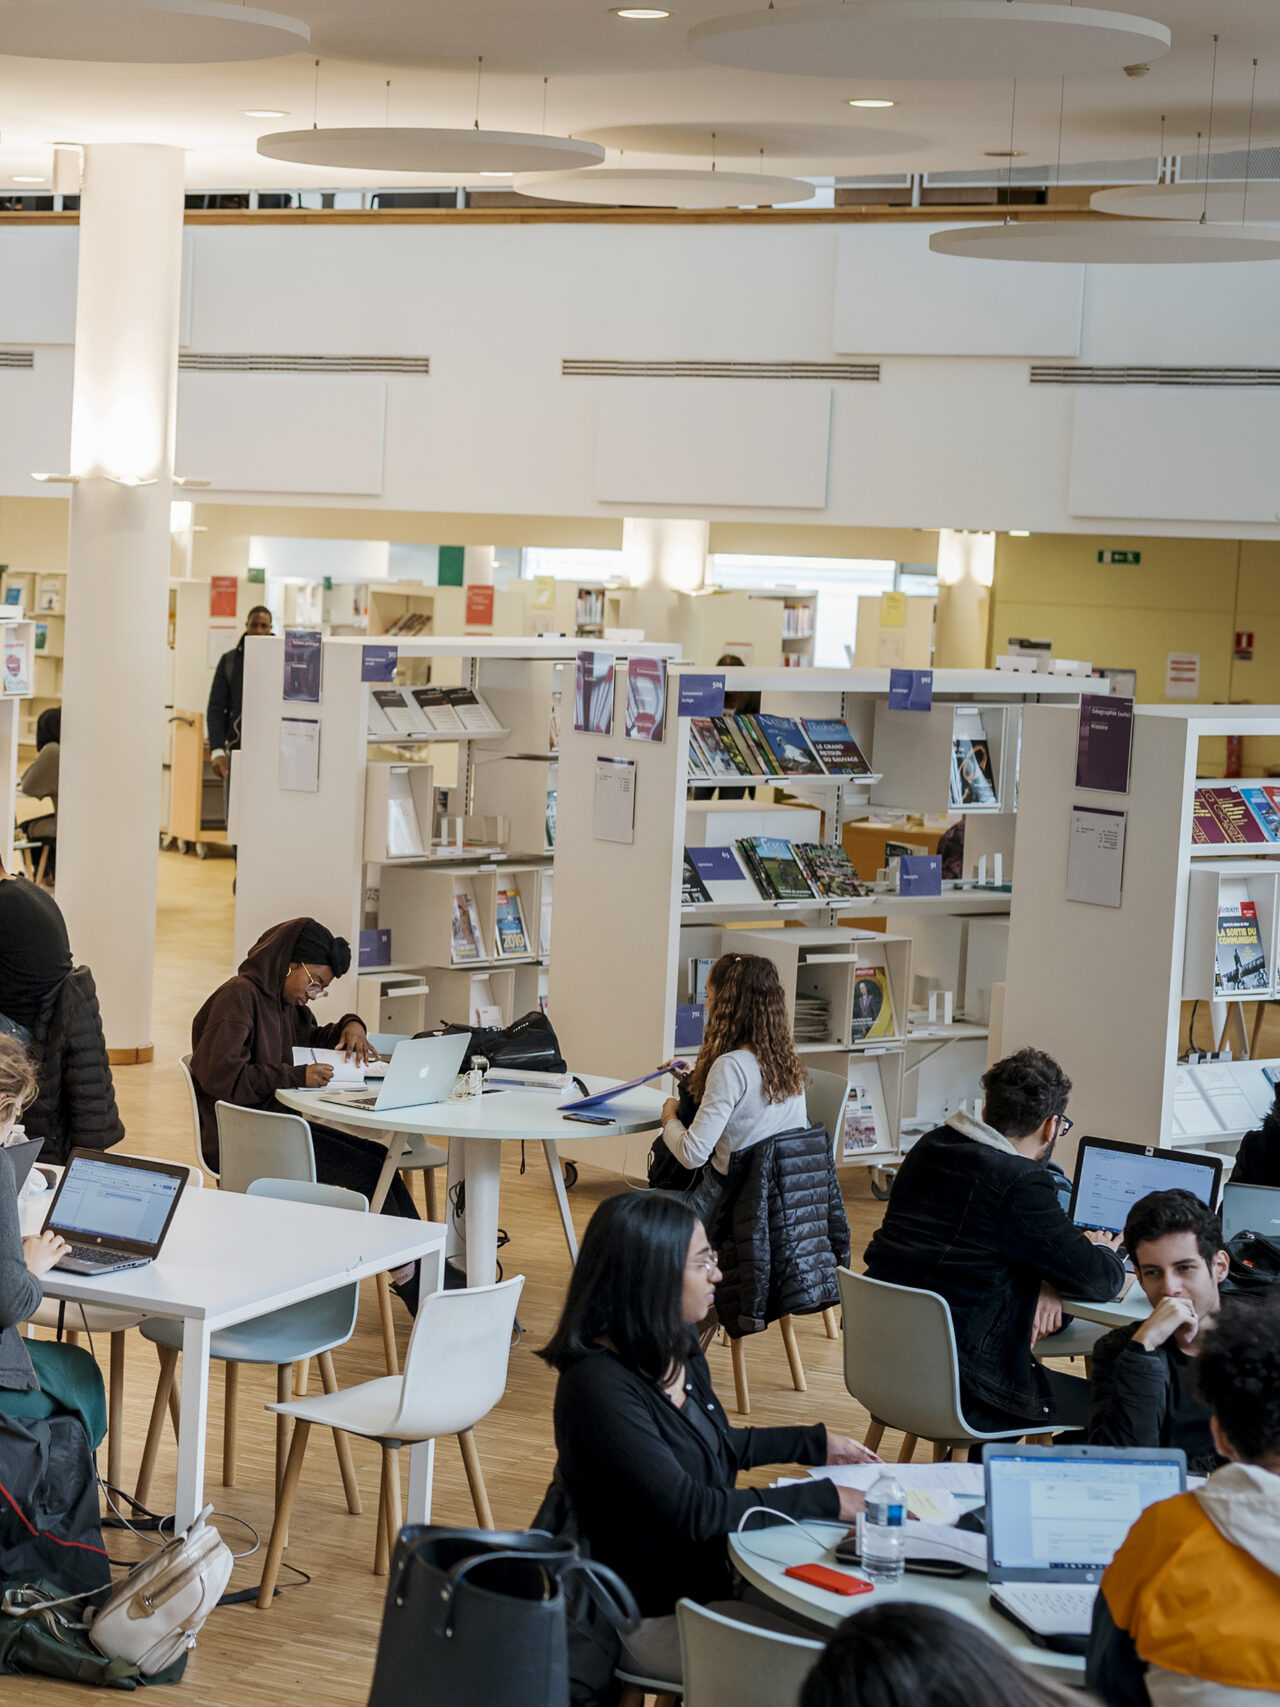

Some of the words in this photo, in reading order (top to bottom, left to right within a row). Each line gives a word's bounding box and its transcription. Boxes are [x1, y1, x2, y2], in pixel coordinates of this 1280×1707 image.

[1091, 707, 1117, 716] Géographie
[1090, 723, 1109, 731] Histoire
[823, 743, 844, 751] GRAND
[1226, 928, 1247, 936] SORTIE
[1248, 927, 1257, 936] DU
[502, 933, 525, 949] 2019
[1219, 936, 1258, 944] COMMUNISME
